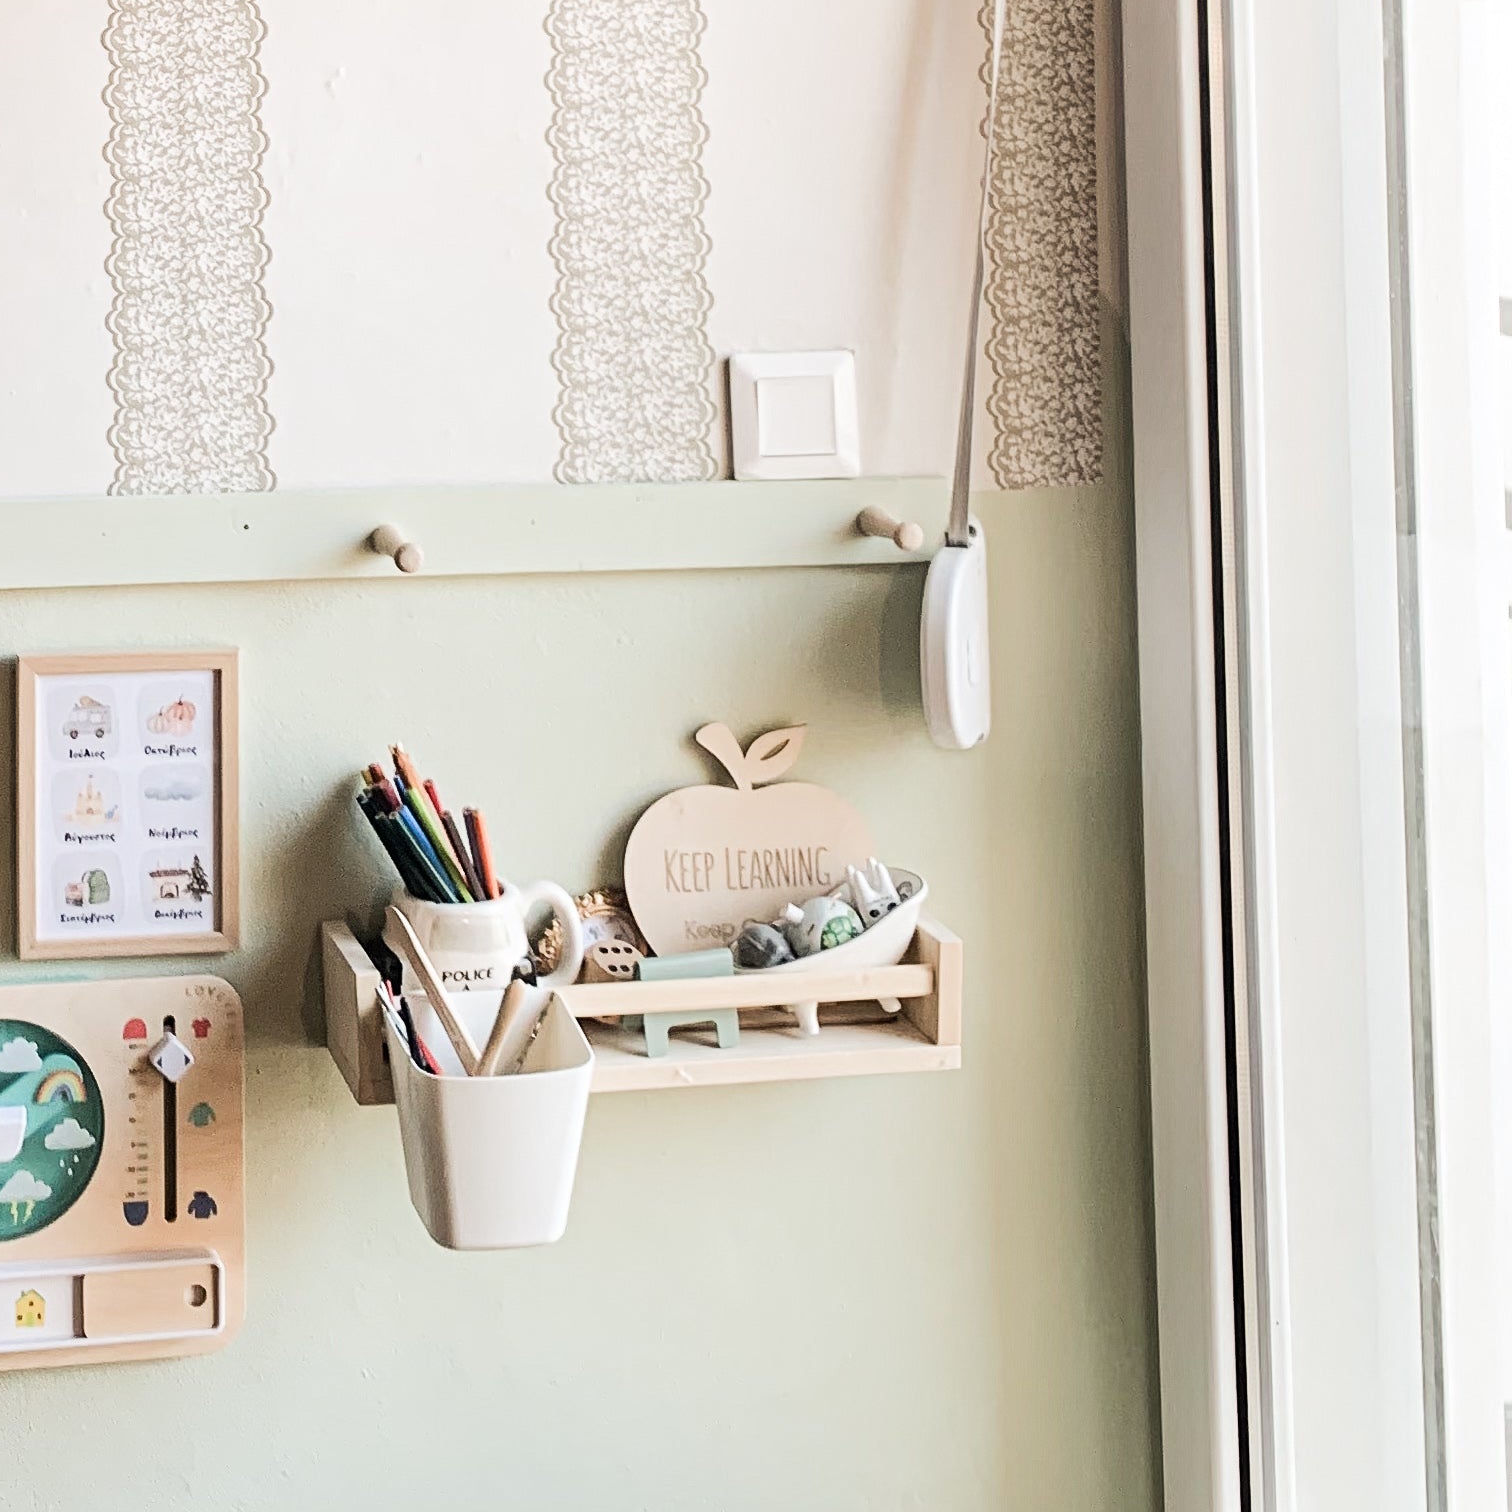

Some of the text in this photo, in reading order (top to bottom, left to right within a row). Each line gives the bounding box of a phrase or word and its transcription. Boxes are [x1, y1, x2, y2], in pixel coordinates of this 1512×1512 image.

[664, 846, 831, 893] KEEP LEARNING
[442, 967, 494, 982] POLICE
